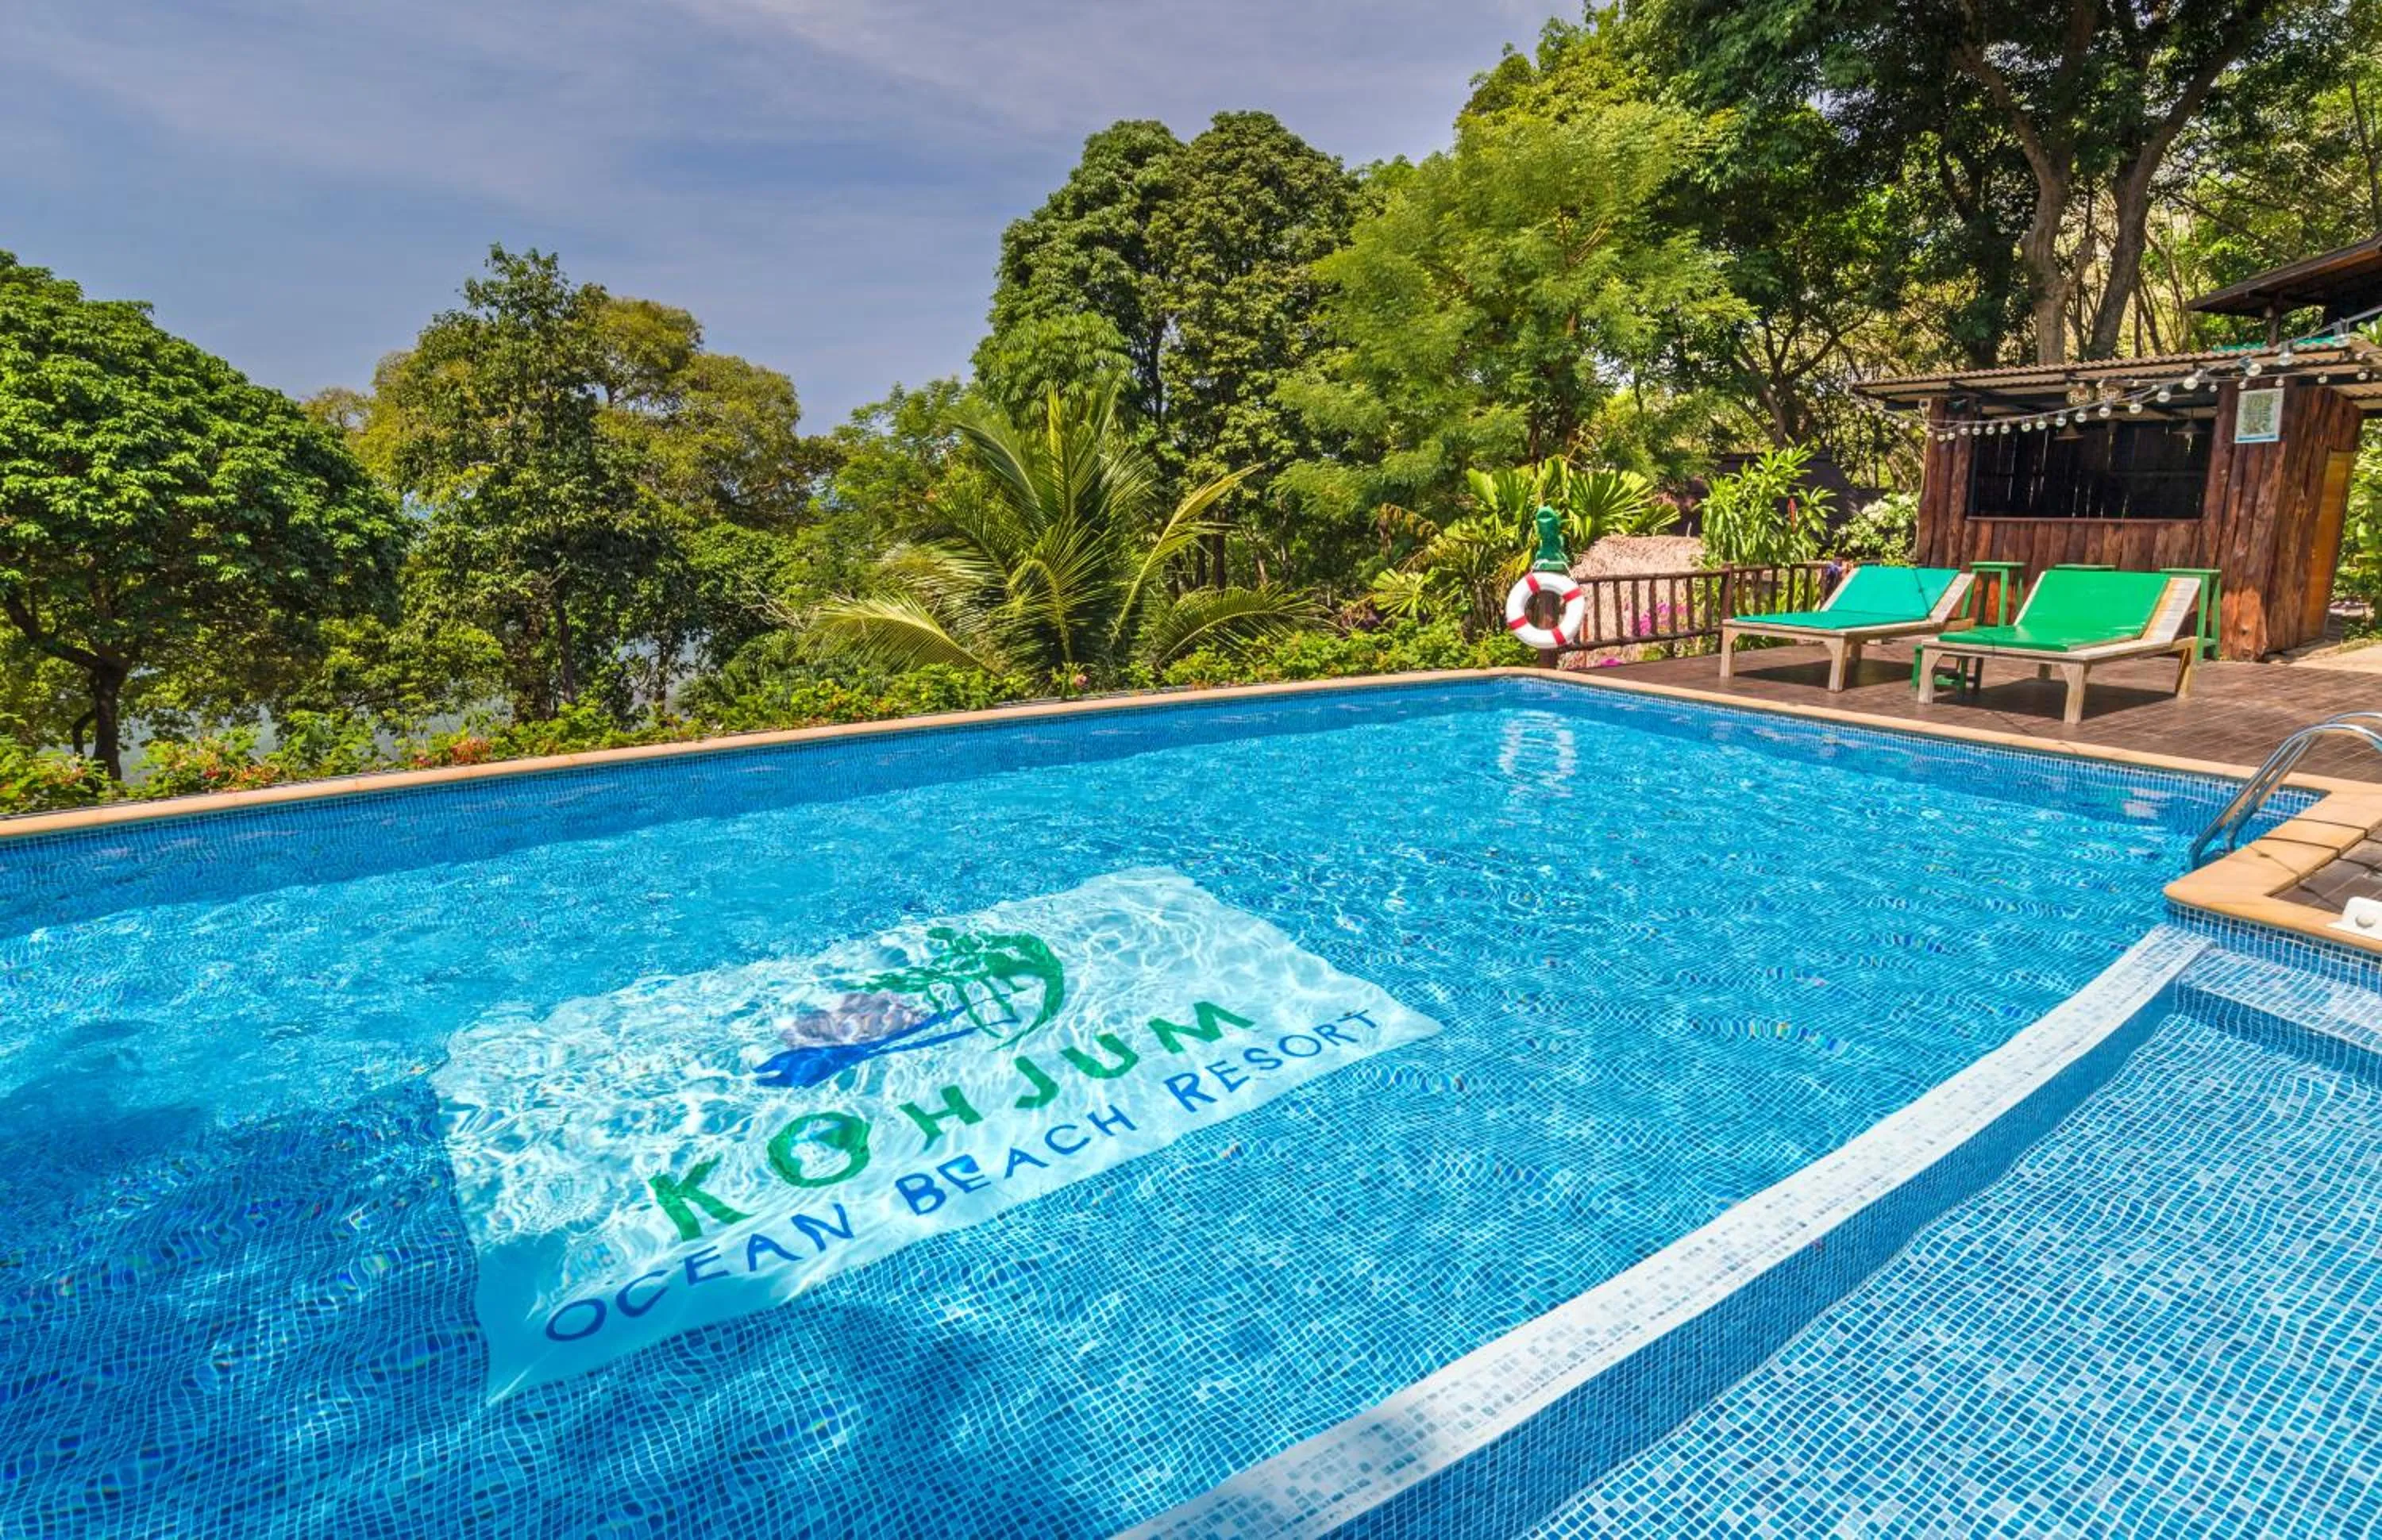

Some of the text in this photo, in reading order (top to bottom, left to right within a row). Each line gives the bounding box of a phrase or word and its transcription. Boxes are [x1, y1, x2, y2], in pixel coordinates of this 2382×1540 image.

[545, 1008, 1378, 1342] OCEAN BEACH RESORT
